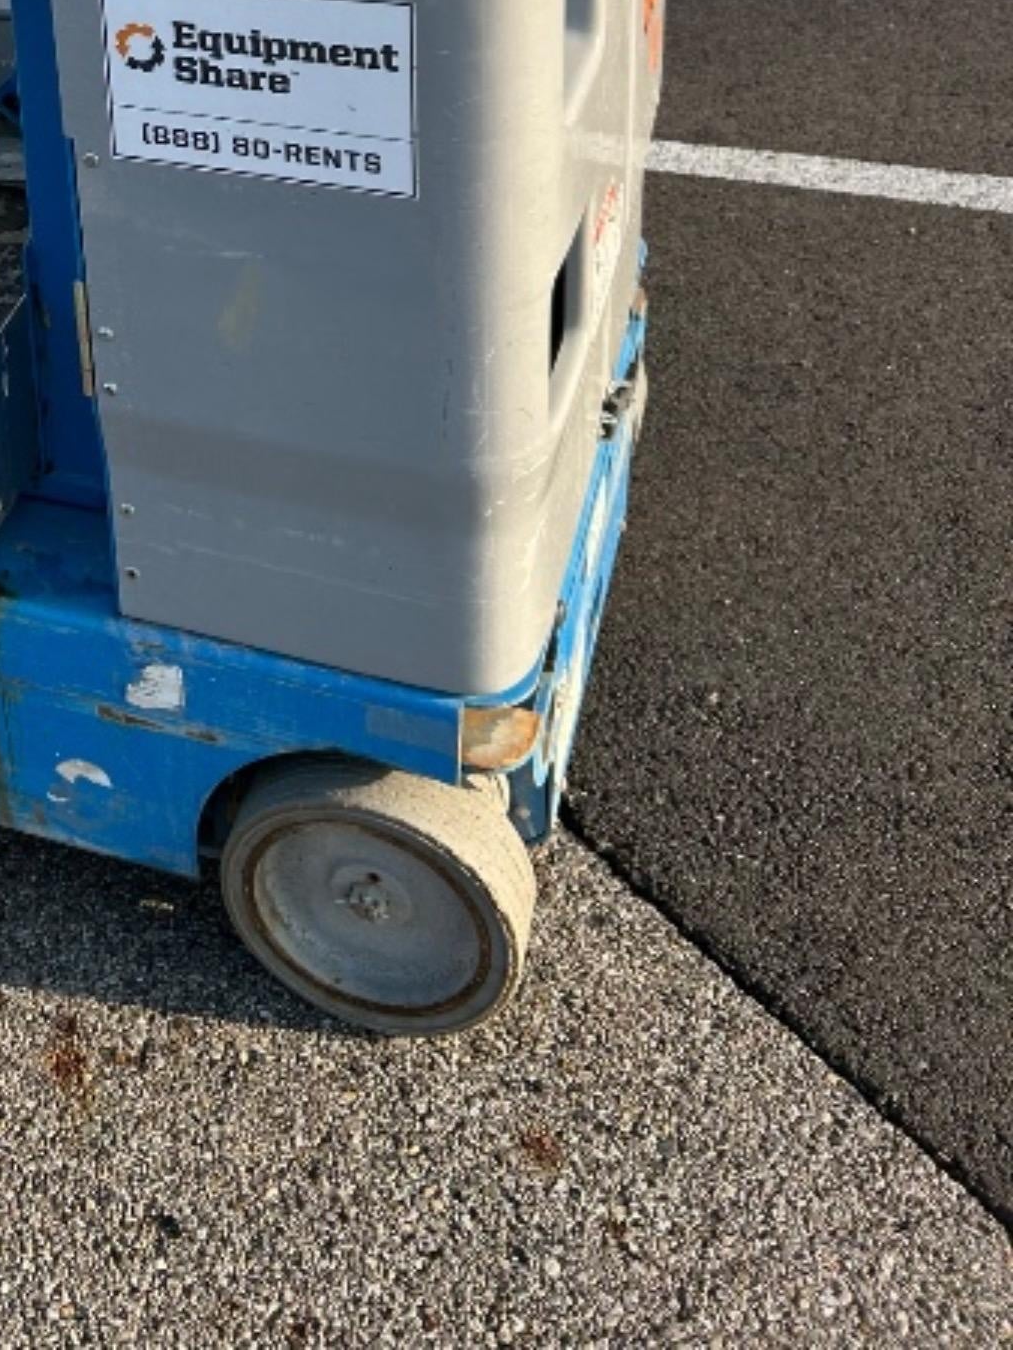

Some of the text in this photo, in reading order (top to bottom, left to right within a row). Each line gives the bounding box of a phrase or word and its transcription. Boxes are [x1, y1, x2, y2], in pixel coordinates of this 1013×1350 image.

[171, 20, 400, 73] Equipment
[173, 56, 292, 95] Share
[142, 122, 382, 175] (888) 80-RENTS
